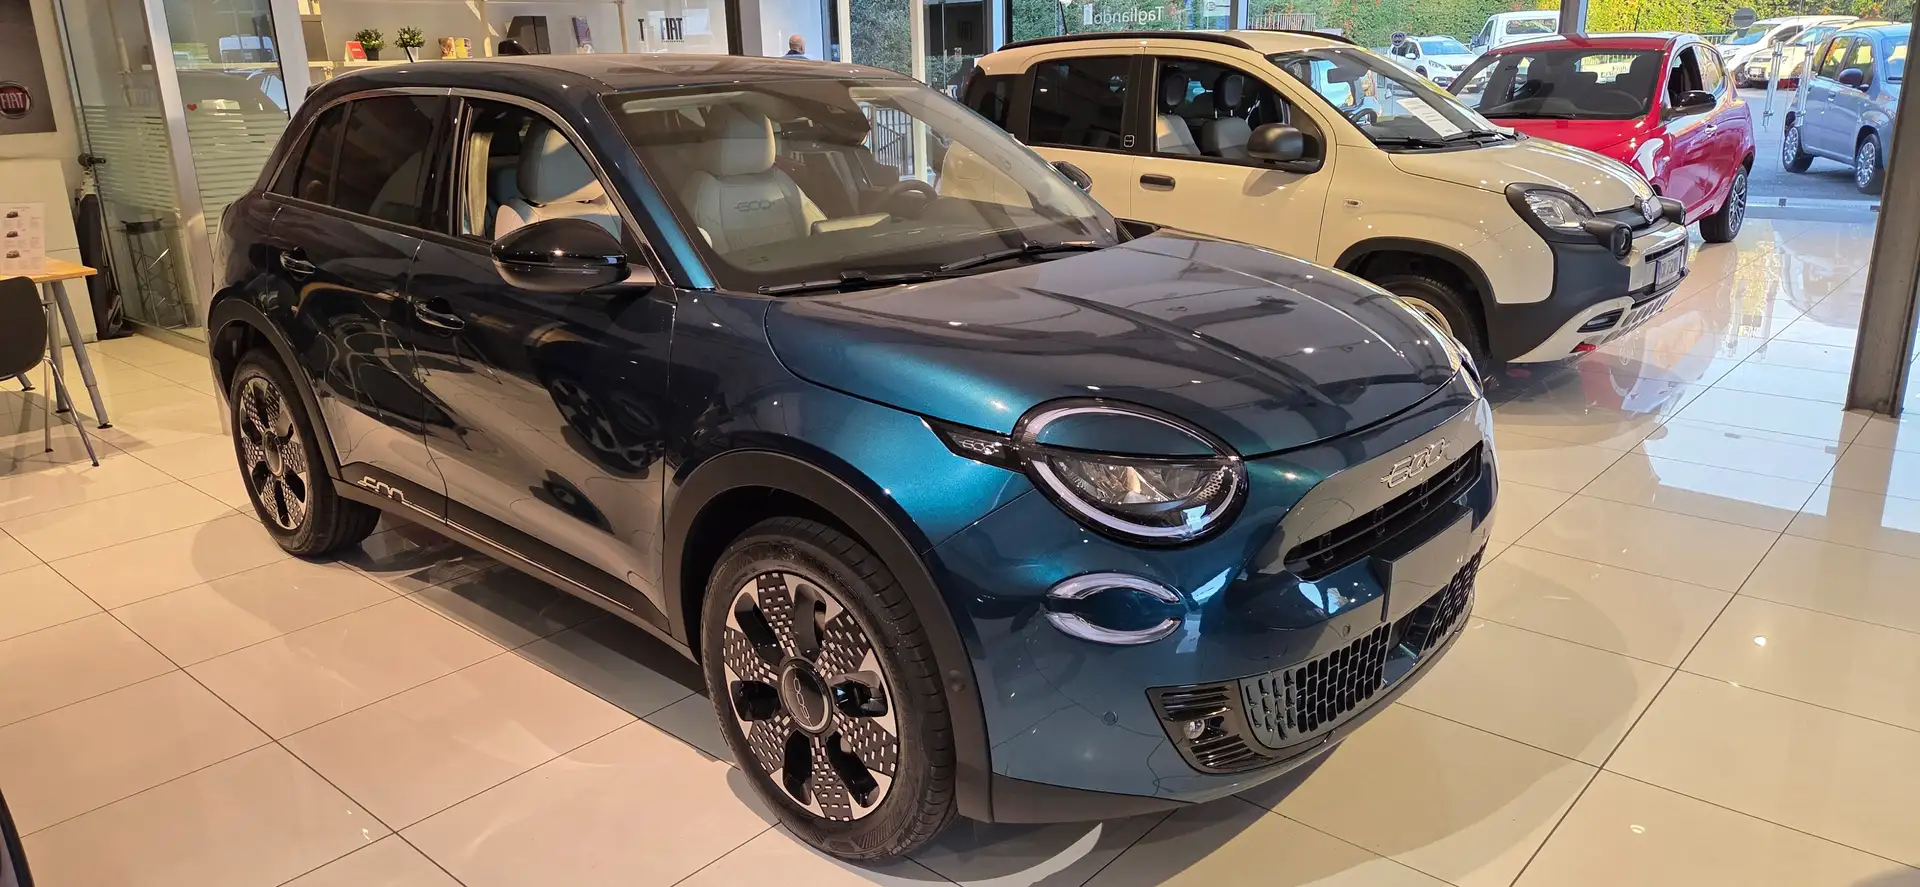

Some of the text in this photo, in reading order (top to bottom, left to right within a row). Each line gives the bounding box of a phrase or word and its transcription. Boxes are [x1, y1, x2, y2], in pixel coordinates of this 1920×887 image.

[660, 17, 683, 40] FIAT
[0, 92, 24, 110] FIAT
[1380, 437, 1450, 488] 600
